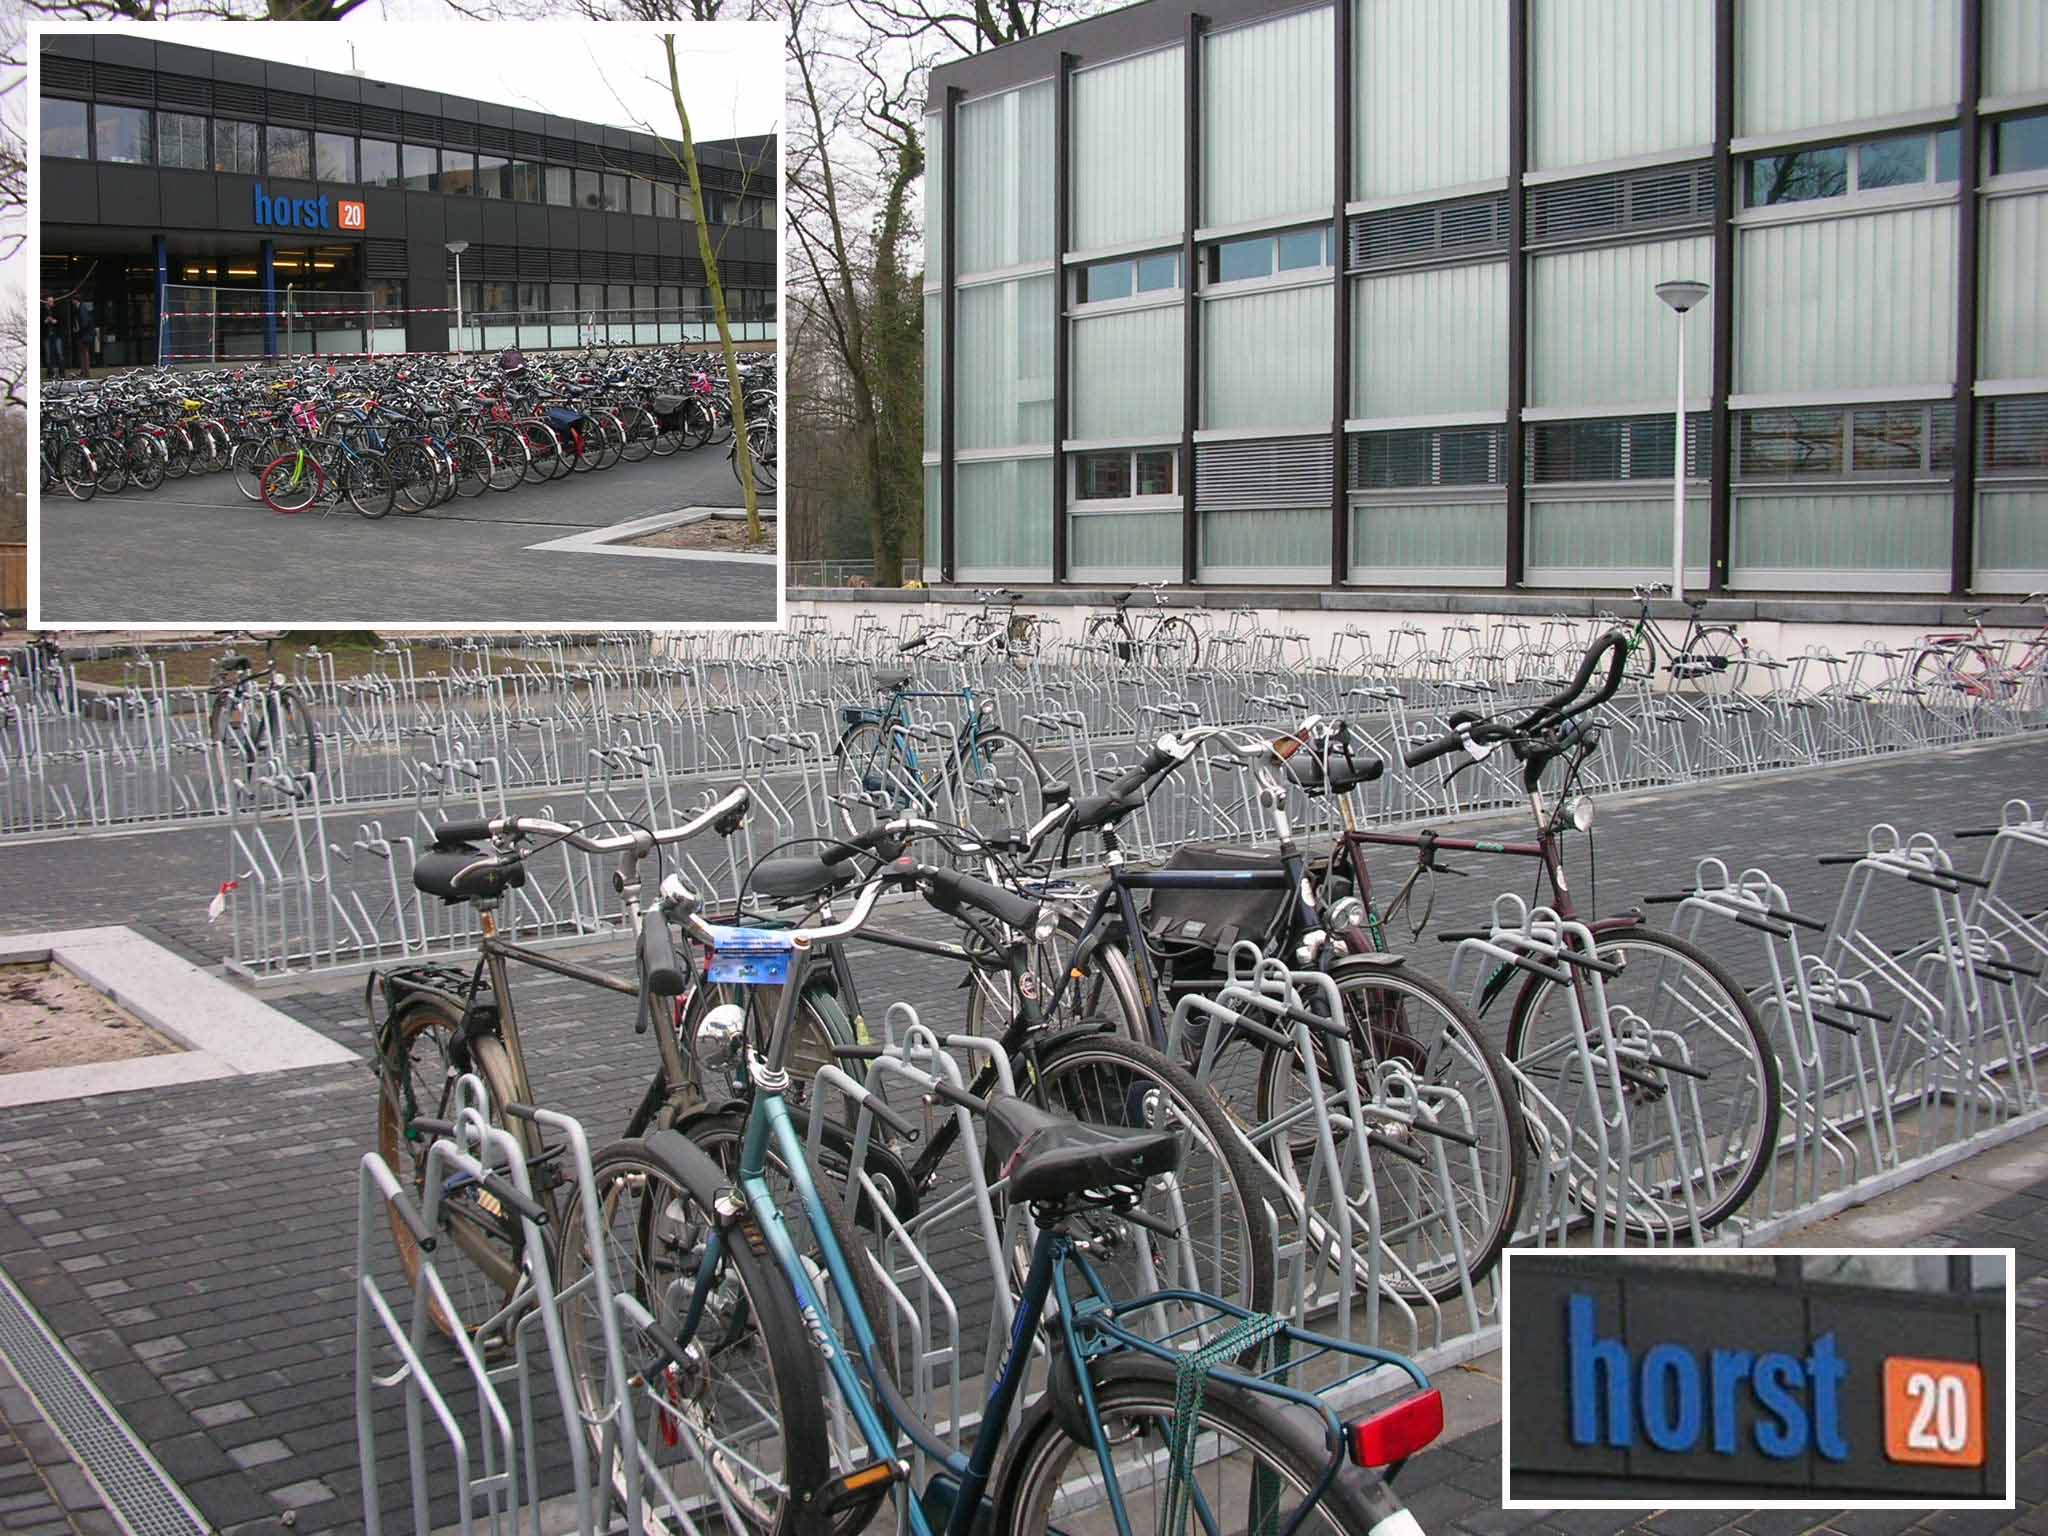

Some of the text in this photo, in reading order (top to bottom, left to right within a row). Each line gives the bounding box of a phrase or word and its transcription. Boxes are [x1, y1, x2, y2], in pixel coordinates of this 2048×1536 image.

[255, 183, 361, 229] horst 20
[1569, 1293, 1967, 1463] horst 20
